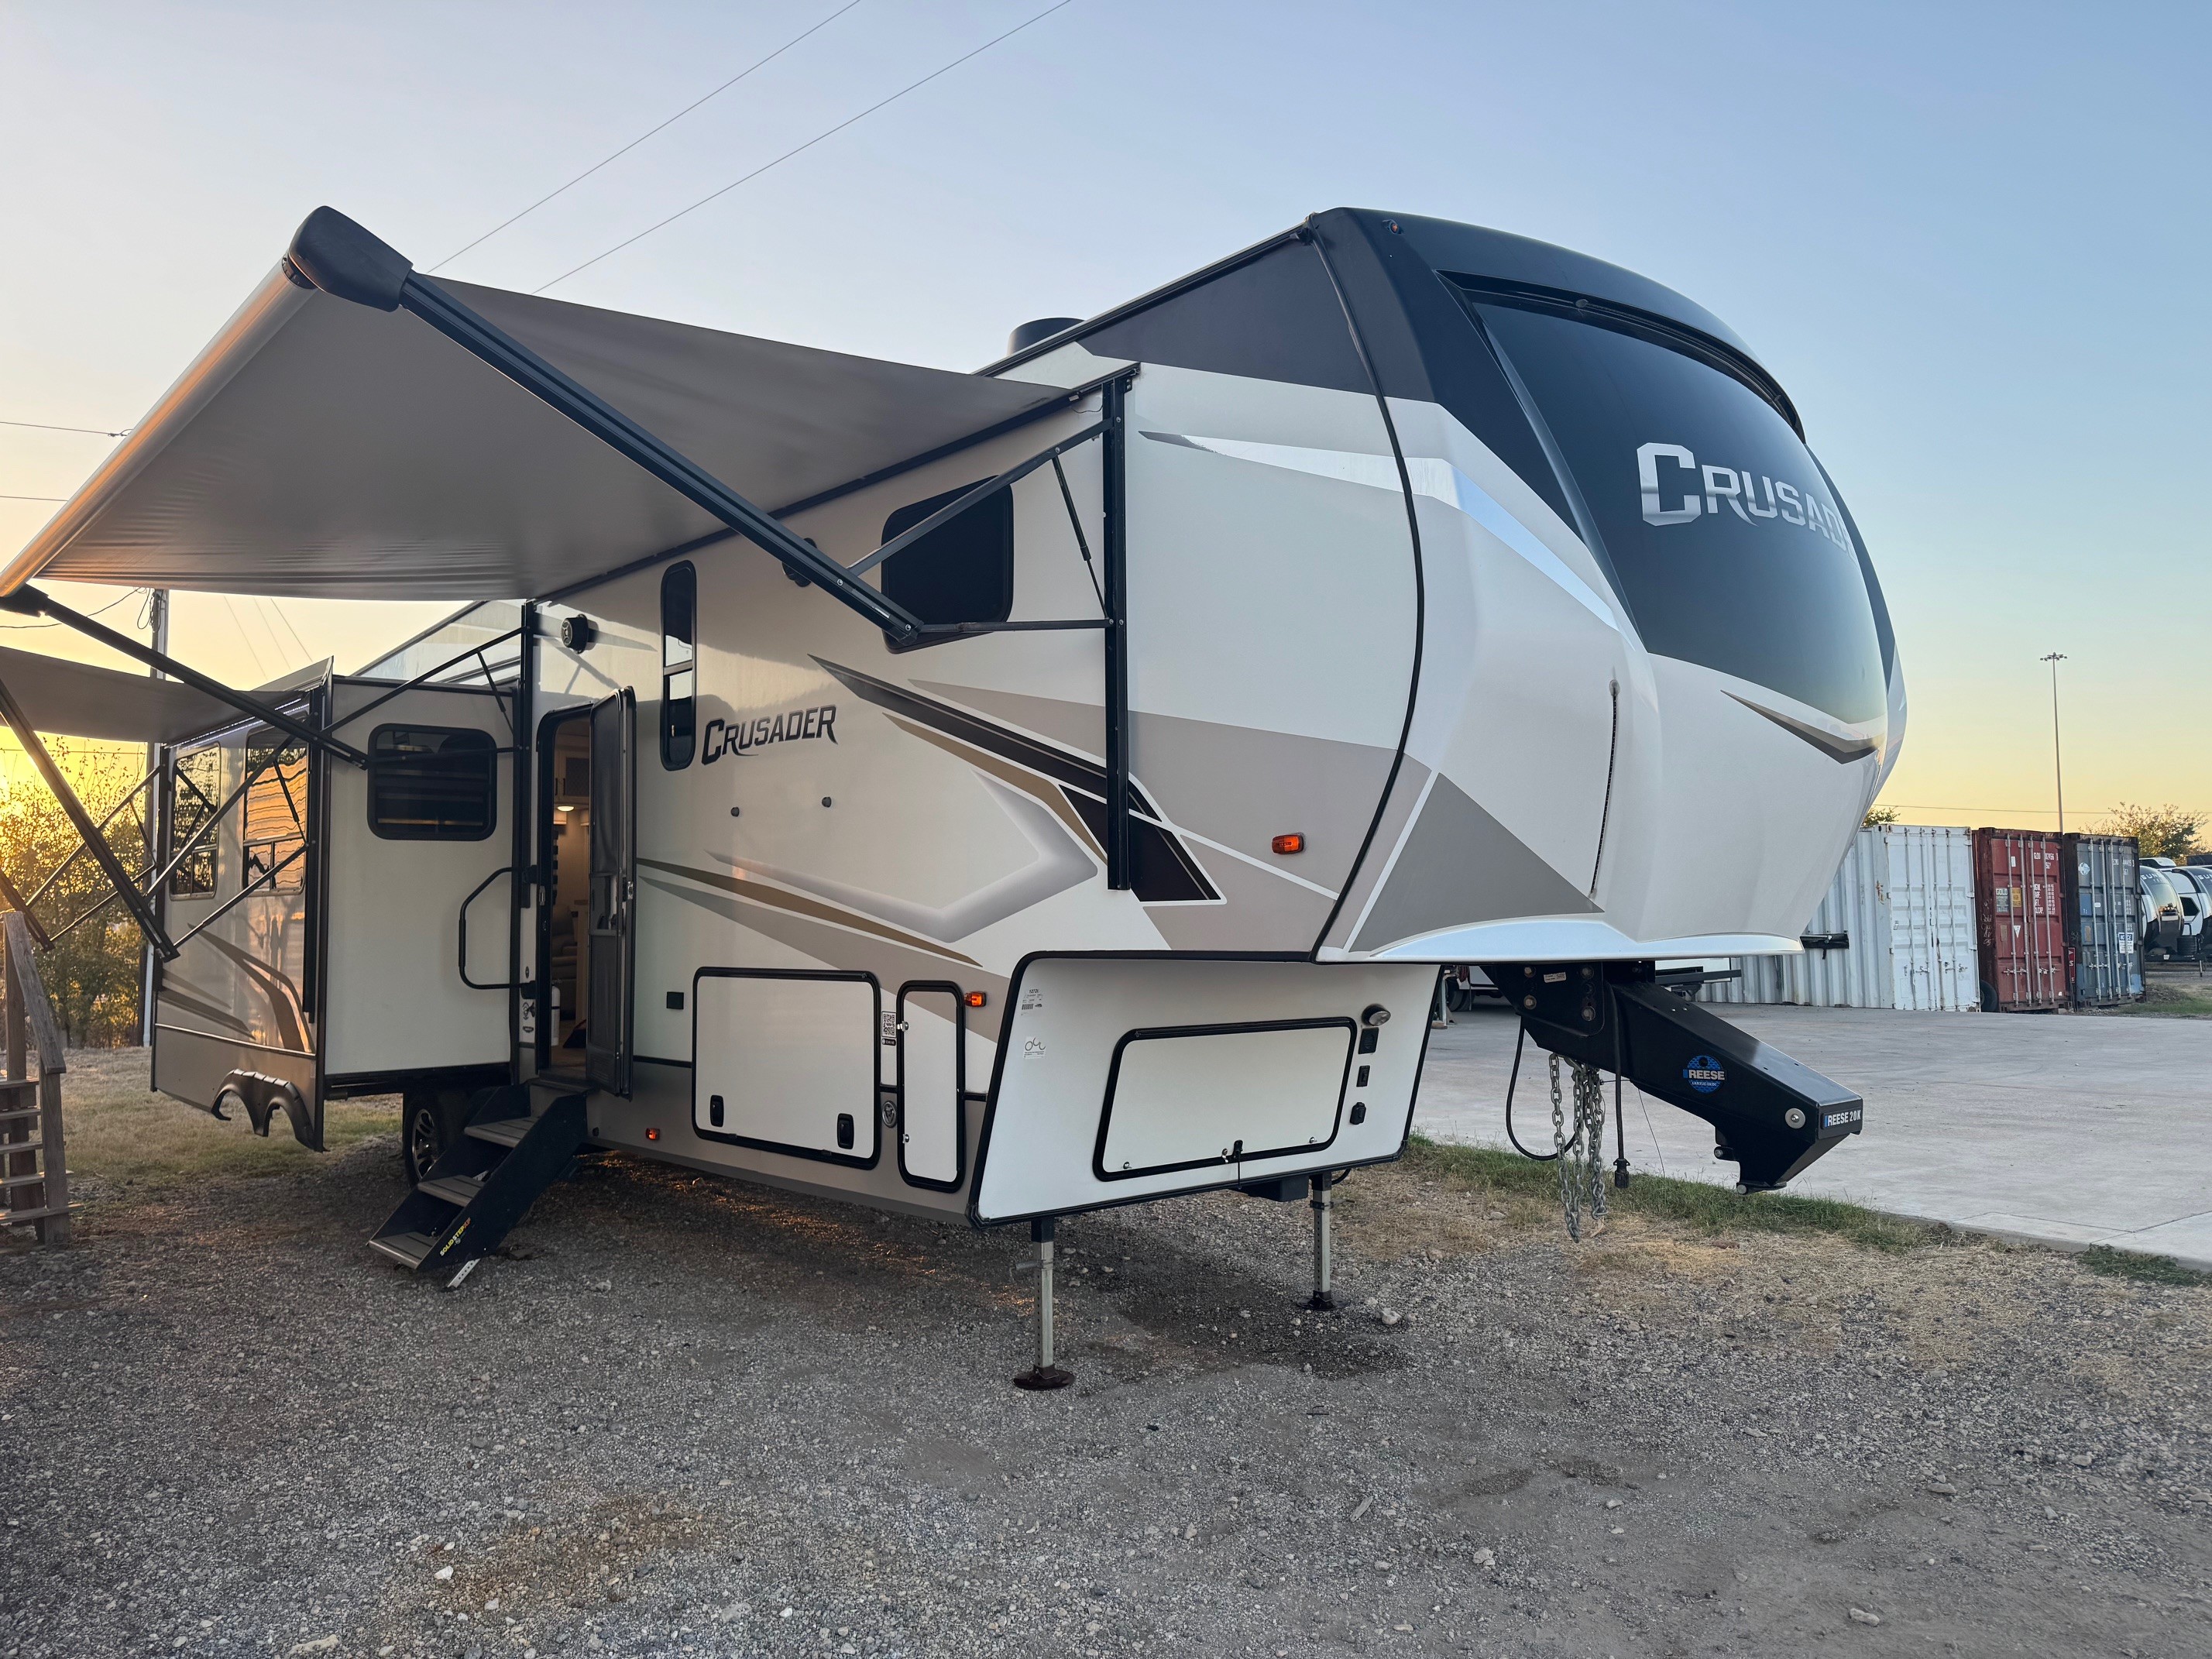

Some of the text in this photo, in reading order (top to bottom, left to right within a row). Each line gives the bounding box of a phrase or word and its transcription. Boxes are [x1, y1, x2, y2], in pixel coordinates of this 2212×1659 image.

[701, 704, 839, 766] CRUSADER
[1688, 1070, 1725, 1080] REESE
[1828, 1110, 1861, 1127] REESE 20K
